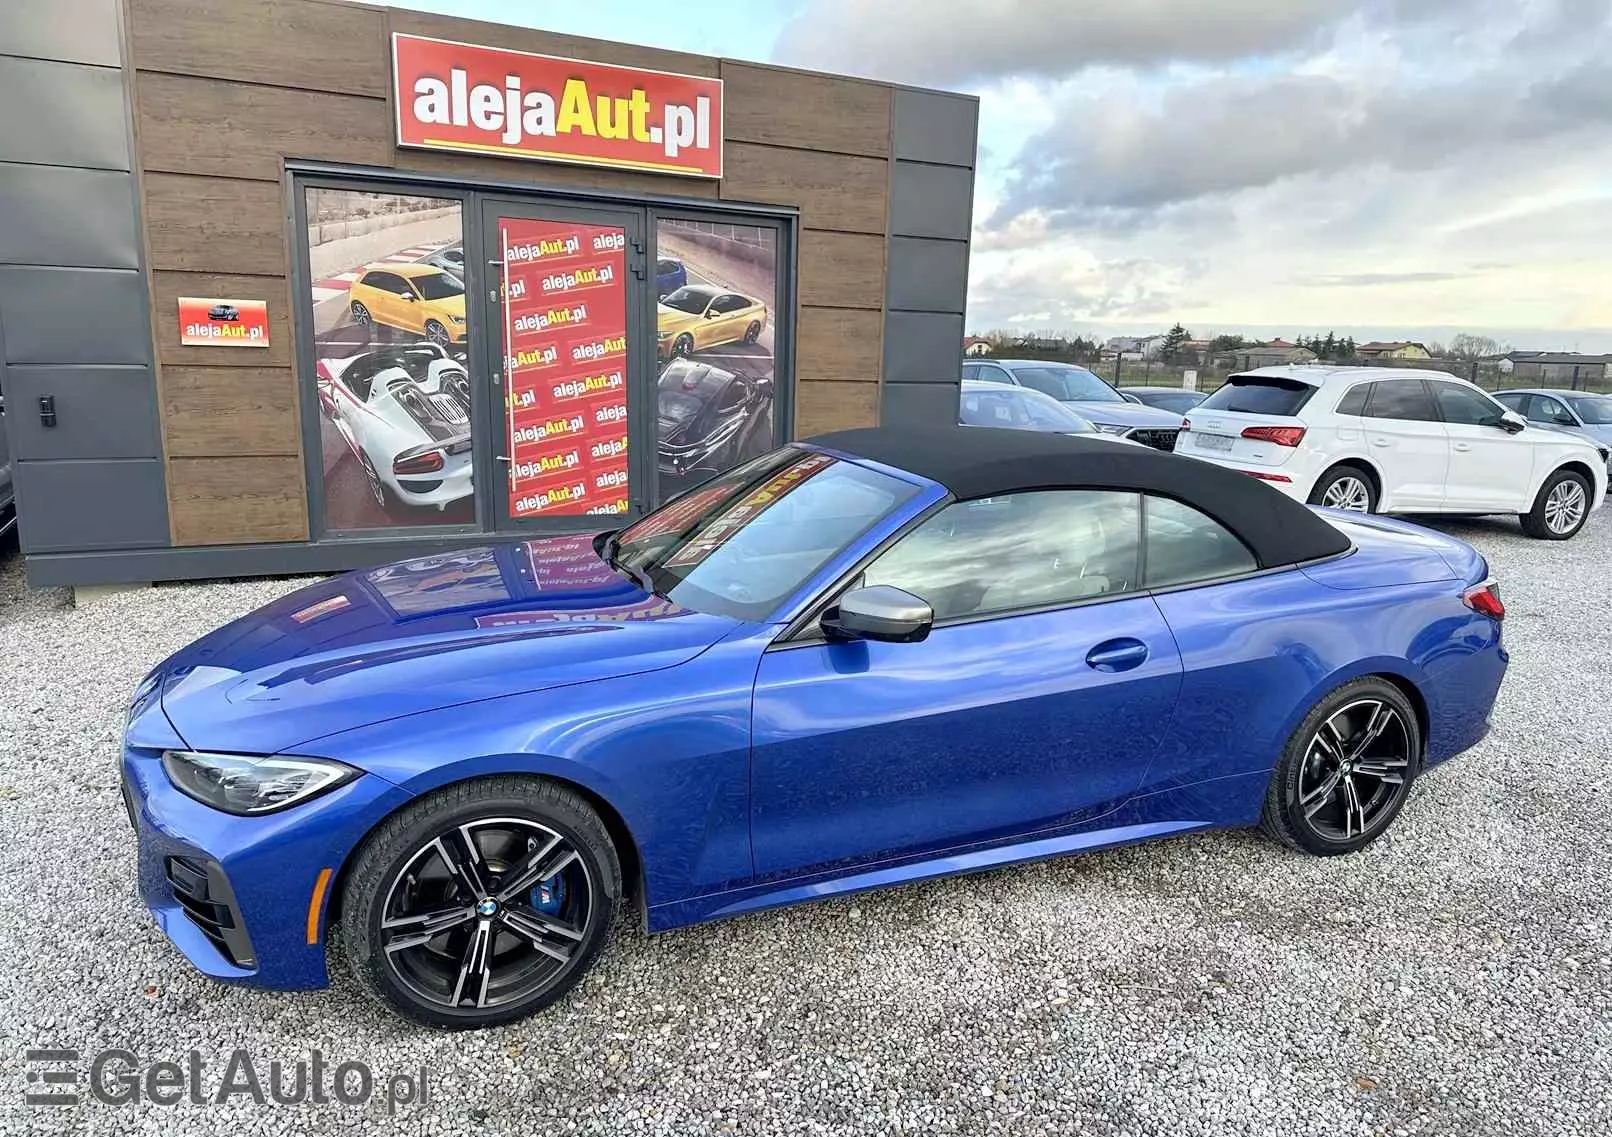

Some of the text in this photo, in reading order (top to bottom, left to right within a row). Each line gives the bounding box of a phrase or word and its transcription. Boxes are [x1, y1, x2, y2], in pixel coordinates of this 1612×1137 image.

[413, 68, 710, 157] alejaAut.pl
[508, 236, 579, 261] alejaAut.pl
[593, 232, 624, 249] aleja
[542, 266, 613, 290] alejaAut.pl
[514, 305, 587, 331] alejaAut.pl
[186, 323, 263, 340] alejaAut.pl
[572, 337, 626, 359] alejaAut
[553, 372, 622, 398] alejaAut.pl
[595, 405, 627, 421] aleja
[514, 416, 584, 443] alejaAut.pl
[515, 483, 586, 511] alejaAut.pl
